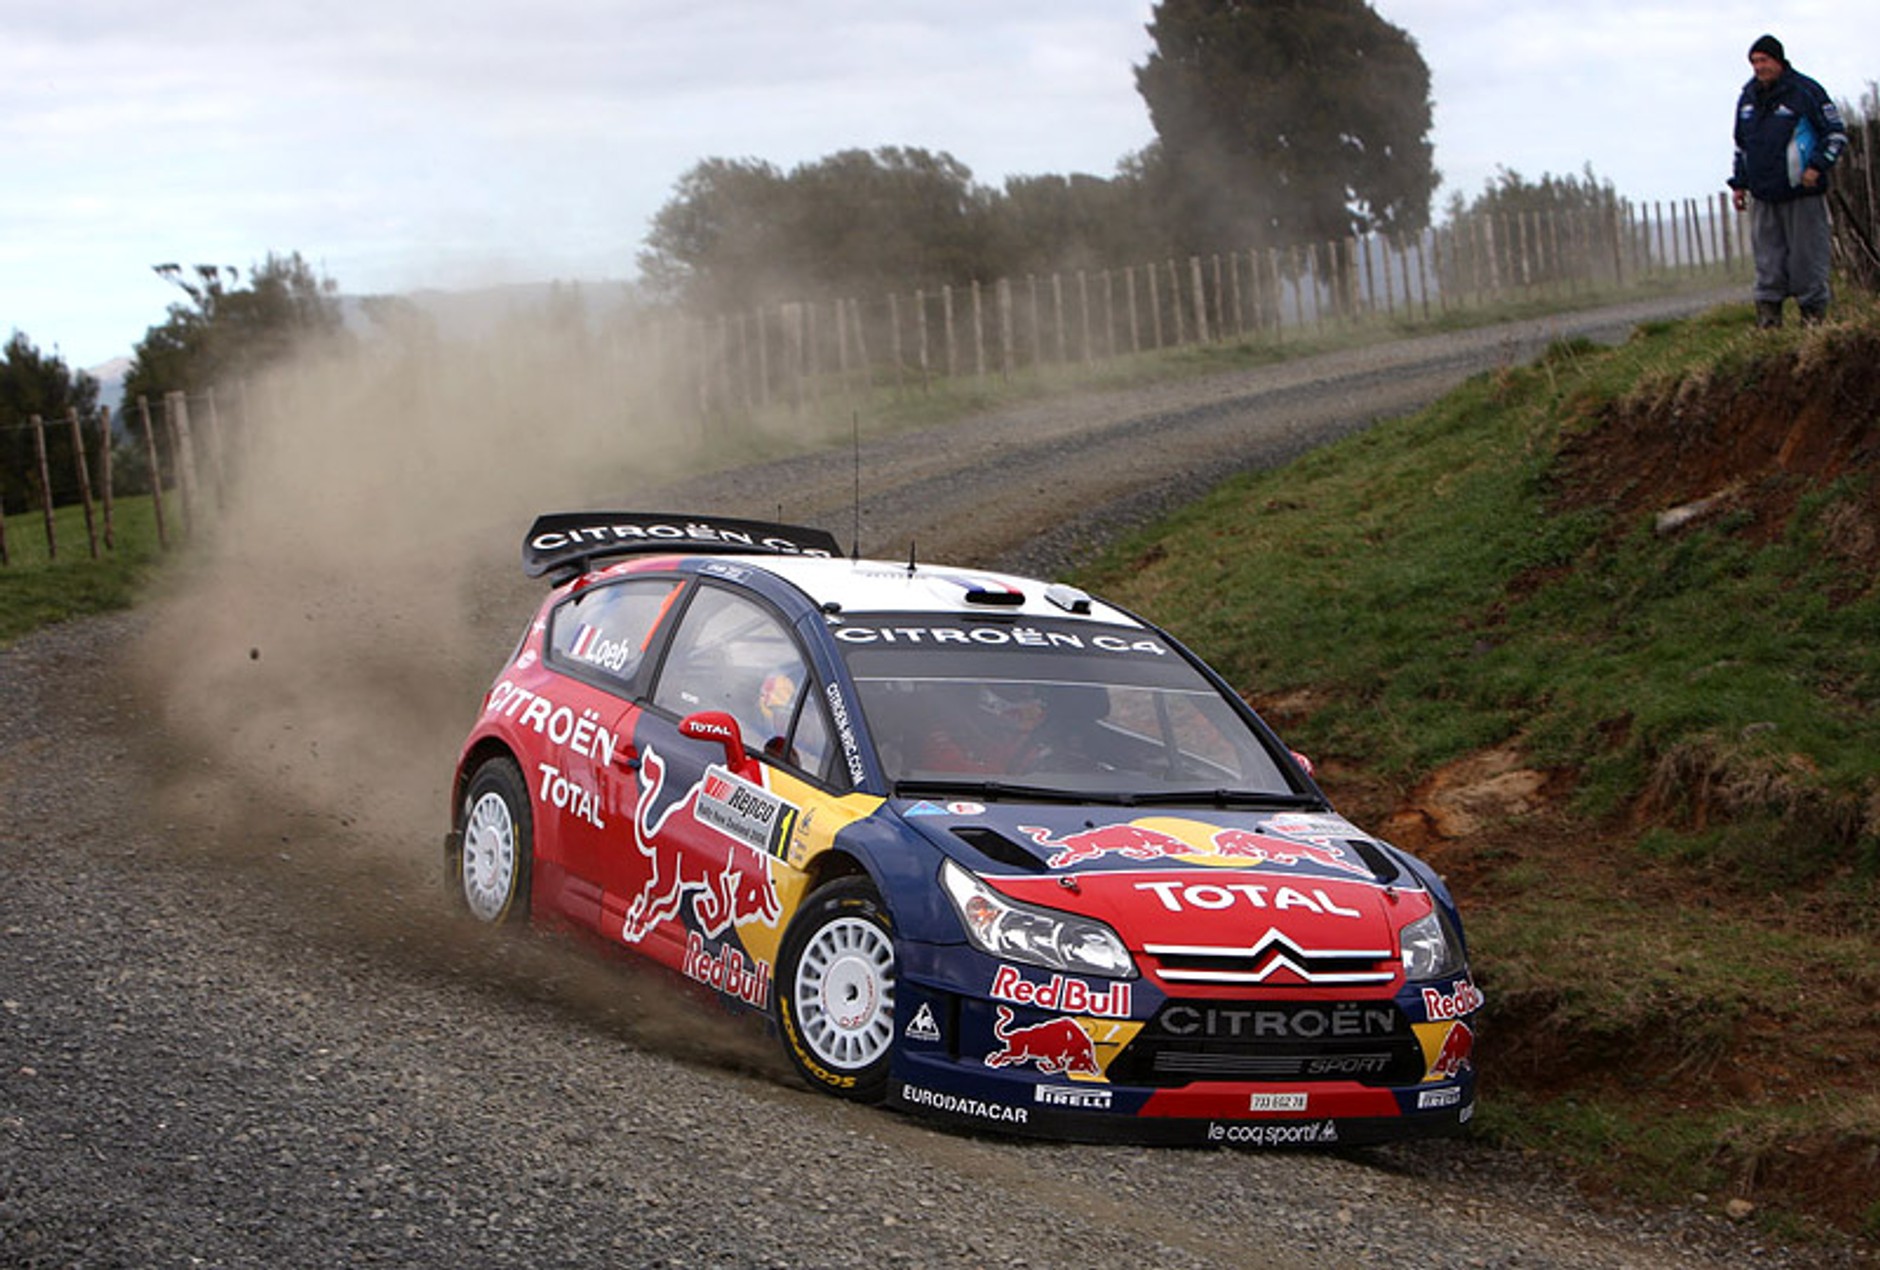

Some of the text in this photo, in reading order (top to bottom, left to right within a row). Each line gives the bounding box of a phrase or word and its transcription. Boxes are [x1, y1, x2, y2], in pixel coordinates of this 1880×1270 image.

[532, 523, 753, 549] CITROËN
[585, 628, 629, 672] Loeb
[835, 627, 1165, 655] CITROËN C4
[486, 680, 618, 767] CITROËN
[690, 721, 732, 736] TOTAL
[538, 763, 605, 829] TOTAL
[728, 786, 776, 823] Repco
[777, 809, 795, 857] 1
[1135, 881, 1361, 918] TOTAL
[683, 930, 769, 1009] Red Bull
[990, 966, 1131, 1017] Red Bull
[1159, 1003, 1395, 1037] CITROËN
[1308, 1058, 1388, 1074] SPORT
[902, 1083, 1028, 1123] EURODATACAR
[1035, 1084, 1112, 1108] PIRELLI
[1208, 1122, 1320, 1146] le coq sportif
